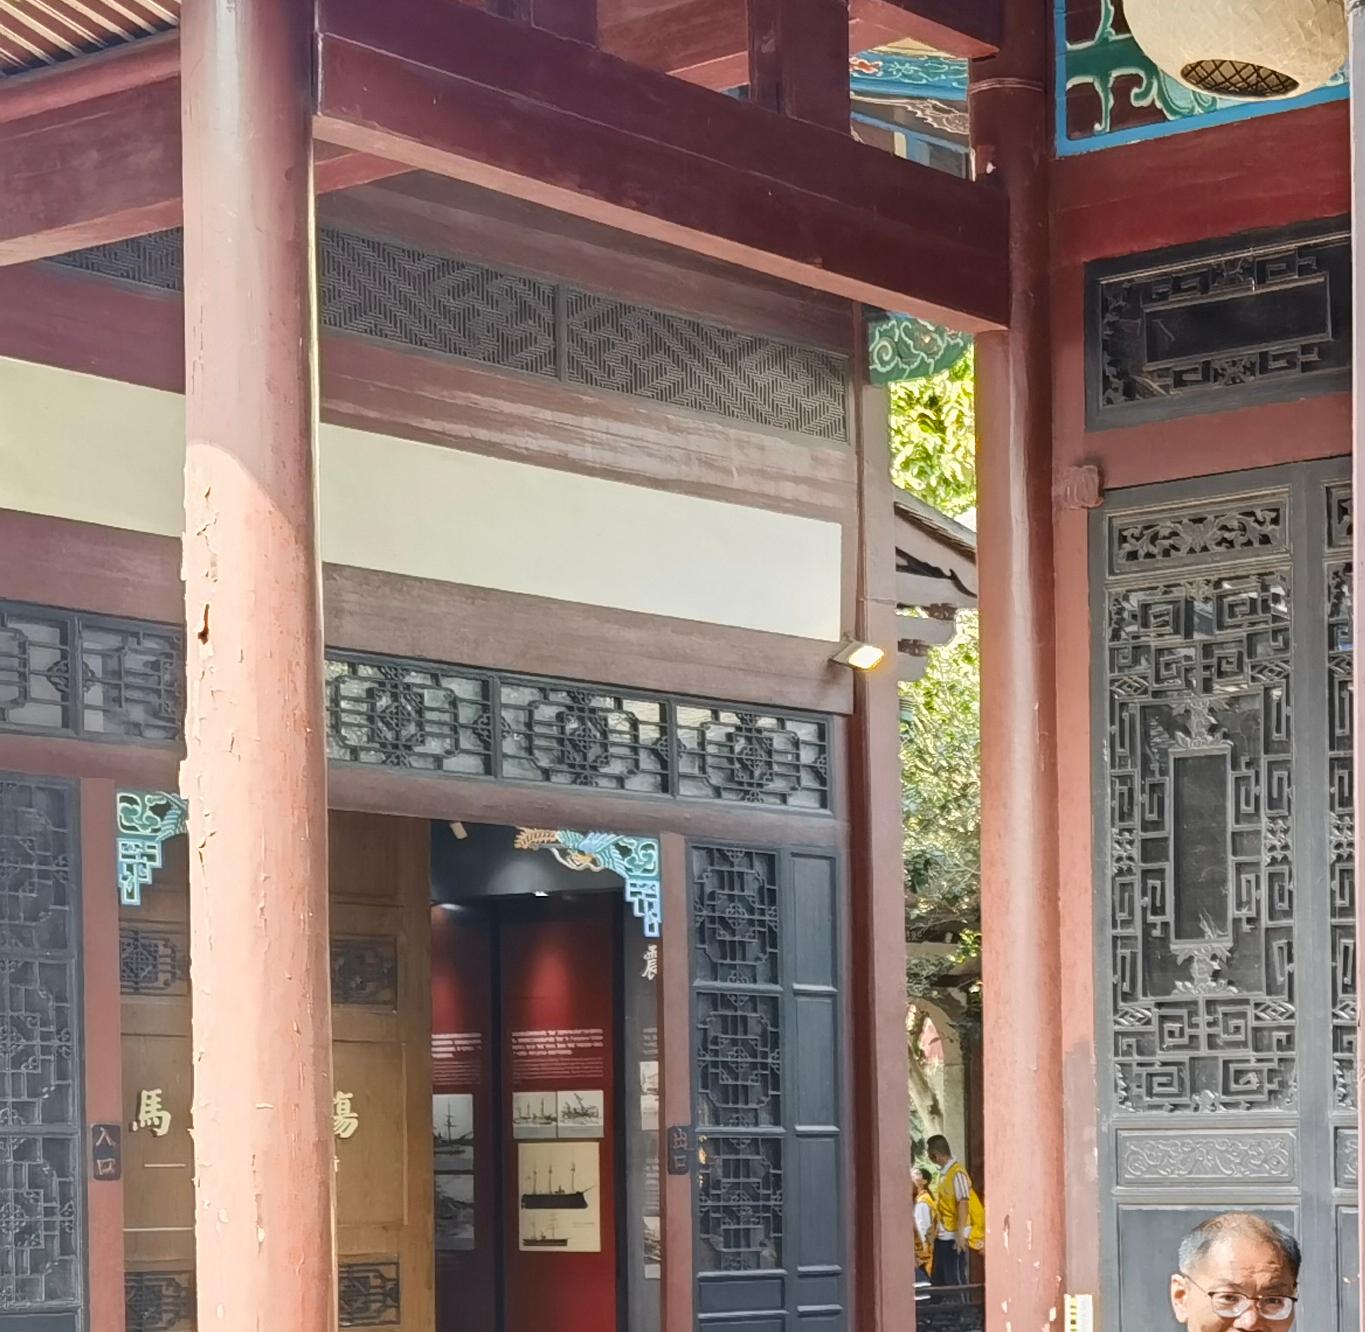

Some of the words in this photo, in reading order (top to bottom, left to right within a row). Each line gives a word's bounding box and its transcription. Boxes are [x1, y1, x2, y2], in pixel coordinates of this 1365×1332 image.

[132, 1088, 171, 1136] 馬
[95, 1126, 116, 1176] 入口
[672, 1128, 688, 1169] 出口
